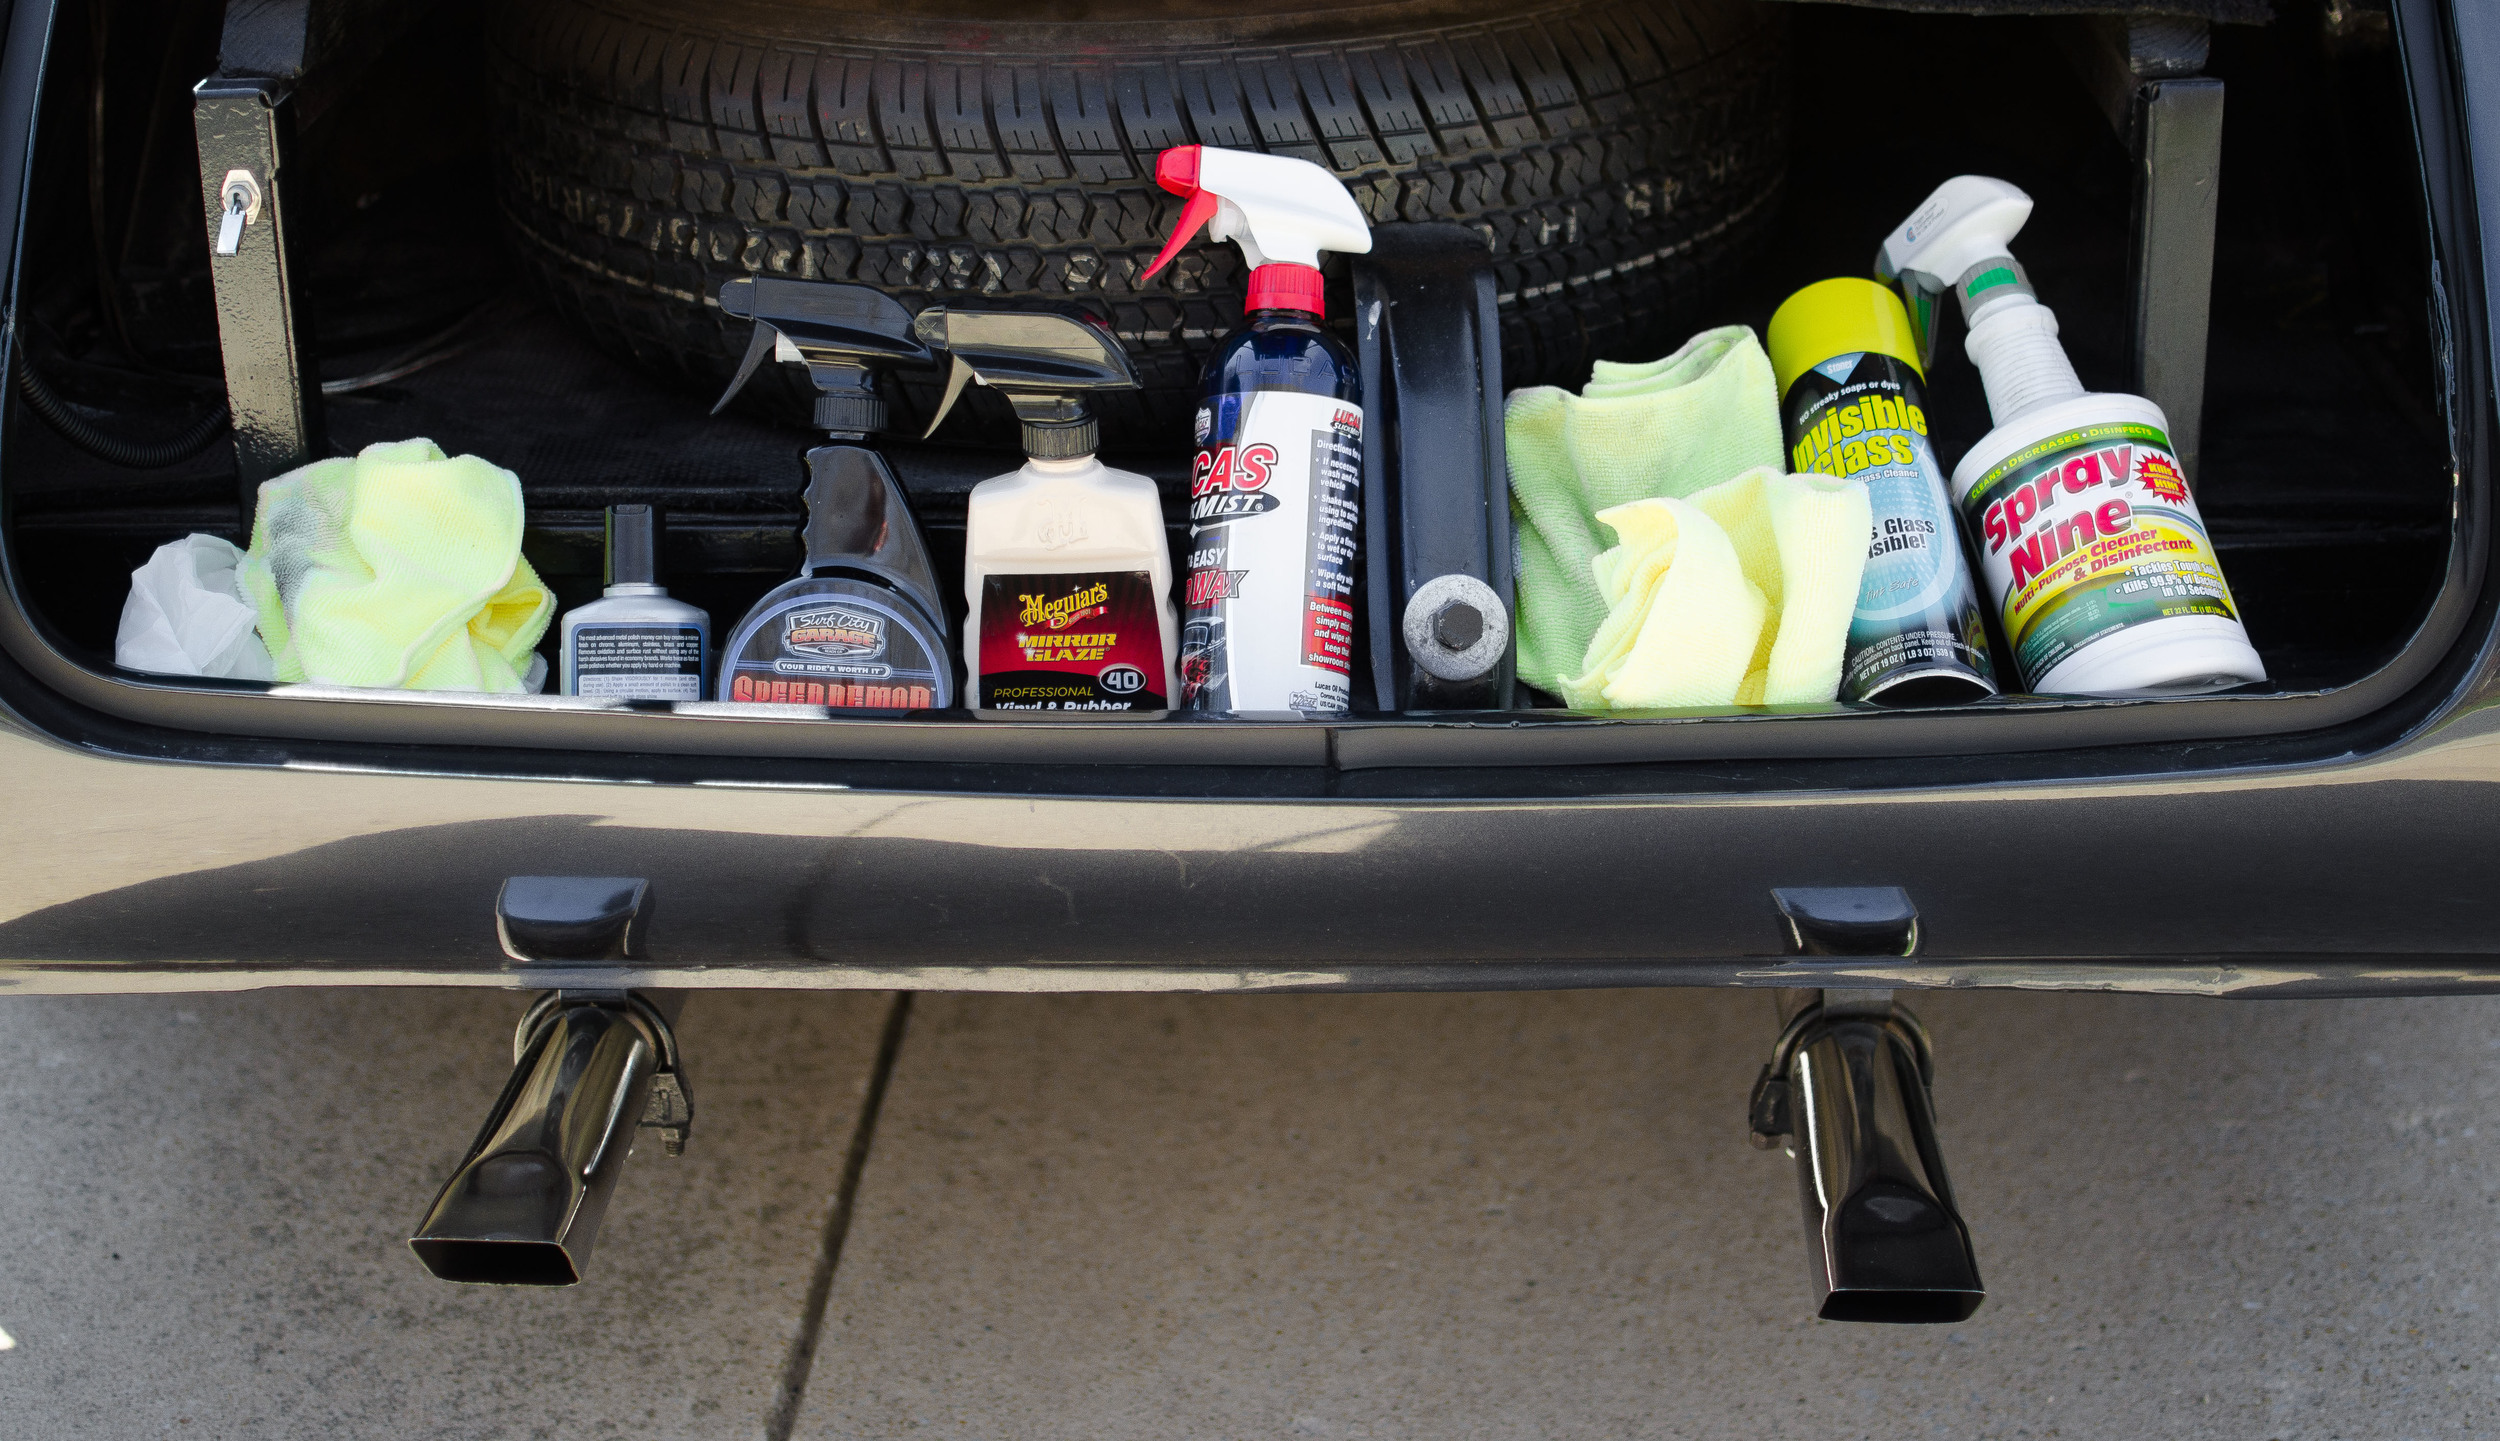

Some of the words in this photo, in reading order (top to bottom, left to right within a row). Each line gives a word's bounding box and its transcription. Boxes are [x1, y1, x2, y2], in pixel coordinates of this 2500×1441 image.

[1799, 410, 1810, 425] NO
[1810, 390, 1839, 414] streaky
[1840, 383, 1867, 397] soaps
[1868, 381, 1879, 389] or
[1880, 380, 1901, 391] dyes
[1792, 394, 1928, 474] Invisible
[1316, 439, 1351, 457] Directions
[1971, 468, 2003, 499] CLEANS
[2008, 433, 2080, 468] DEGREASES
[2089, 426, 2152, 437] DISINFECTS
[1191, 443, 1279, 499] CAS
[1321, 469, 1340, 479] wash
[1857, 471, 1882, 483] lass
[1883, 468, 1920, 480] Cleaner
[1320, 479, 1346, 491] vehicle
[1321, 494, 1342, 506] Shake
[1984, 444, 2133, 556] Spray
[1319, 506, 1339, 518] using
[1340, 508, 1347, 518] to
[1884, 517, 1935, 535] Glass
[1319, 532, 1340, 544] Apply
[2008, 498, 2133, 594] Nine
[2090, 529, 2157, 557] Cleaner
[1317, 542, 1325, 550] to
[1327, 545, 1340, 554] wet
[1868, 534, 1926, 559] isible!
[1193, 547, 1226, 569] EASY
[1317, 553, 1343, 566] surface
[2073, 567, 2087, 582] &
[2091, 539, 2194, 572] Disinfectant
[1317, 568, 1335, 580] Wipe
[1336, 572, 1346, 584] dry
[2132, 561, 2173, 577] Tackles
[2173, 560, 2201, 572] Tough
[1192, 569, 1250, 606] WAX
[1322, 581, 1336, 591] soft
[1865, 586, 1886, 603] Tint
[1889, 576, 1919, 592] Safe
[2122, 579, 2149, 594] Kills
[2150, 573, 2182, 588] 99.9%
[2182, 573, 2193, 584] of
[2161, 586, 2174, 597] in
[2175, 584, 2187, 596] 10
[1019, 582, 1108, 629] Meguiar's
[1310, 601, 1342, 616] Between
[2162, 608, 2174, 616] NET
[800, 614, 836, 628] Surf
[837, 615, 870, 632] City
[1316, 615, 1339, 630] simply
[791, 628, 875, 647] GARAGE
[1018, 633, 1117, 648] MIRROR
[1314, 629, 1330, 638] and
[1330, 631, 1344, 643] wipe
[1026, 648, 1105, 661] GLAZE
[1325, 641, 1341, 655] keep
[1851, 645, 1875, 667] CAUTION:
[1876, 634, 1905, 651] CONTENTS
[1905, 631, 1926, 640] UNDER
[1308, 652, 1344, 667] showroom
[1859, 668, 1870, 681] NET
[1870, 662, 1880, 674] WT
[1881, 658, 1889, 668] 19
[1889, 654, 1899, 664] OZ
[1899, 651, 1906, 662] (1
[1907, 649, 1917, 659] LB
[1917, 648, 1923, 657] 3
[1923, 647, 1936, 658] OZ)
[1937, 648, 1949, 657] 539
[781, 663, 805, 671] YOUR
[806, 664, 835, 672] RIDE'S
[838, 666, 868, 674] WORTH
[1106, 672, 1138, 689] 40
[1315, 681, 1331, 690] Lucas
[994, 686, 1094, 698] PROFESSIONAL
